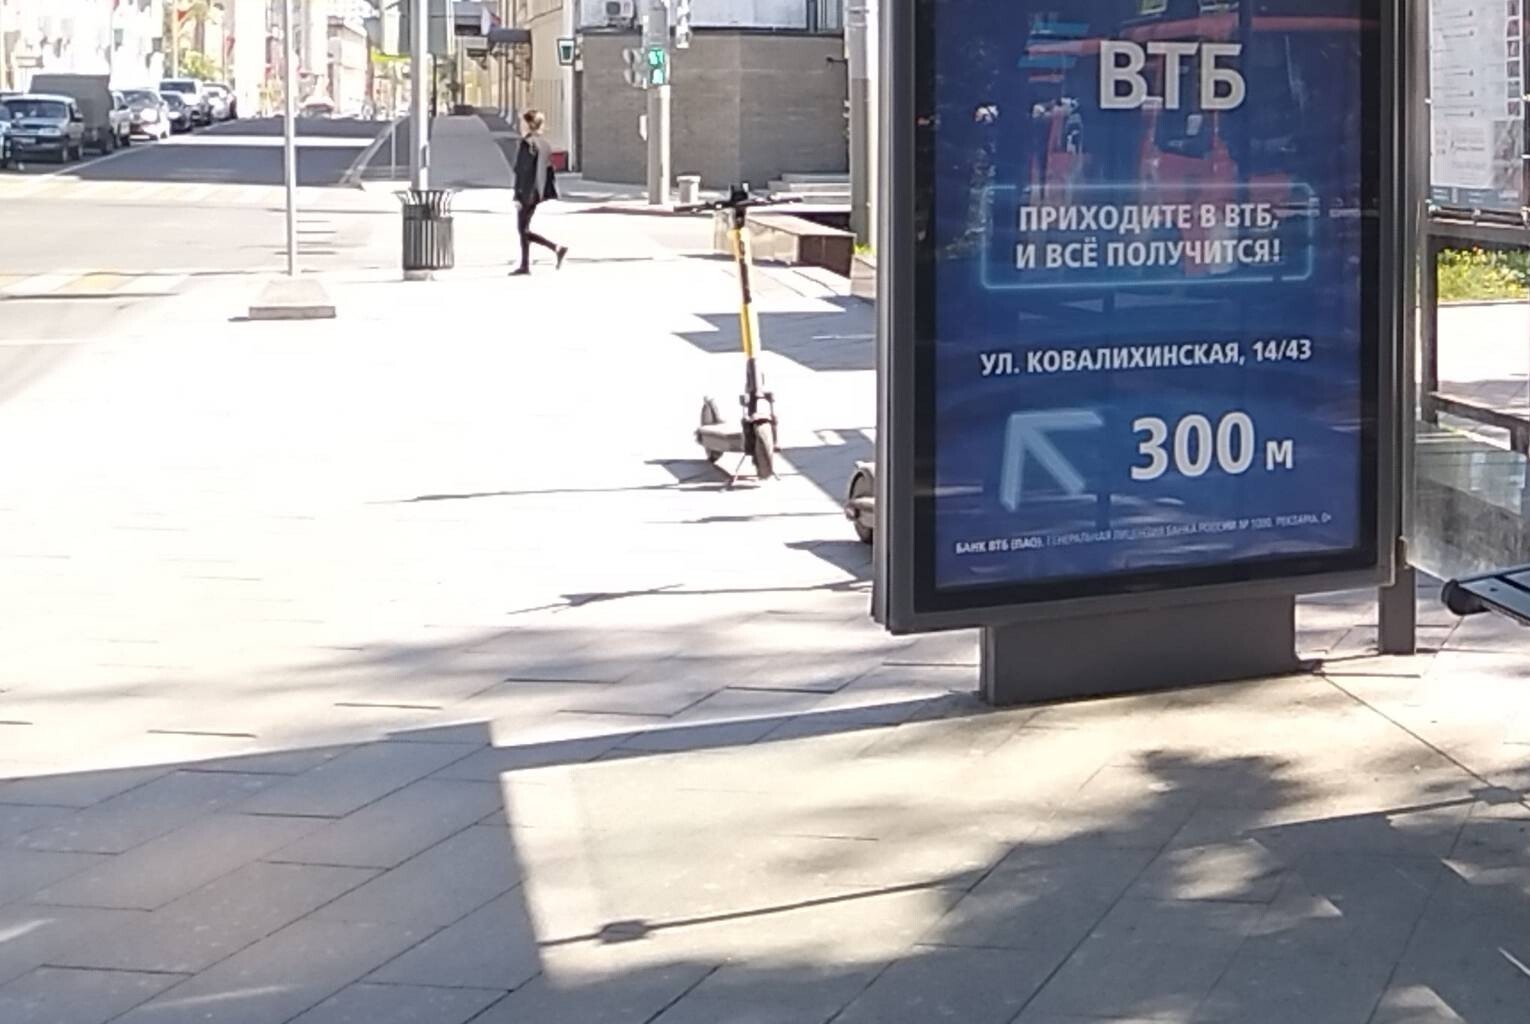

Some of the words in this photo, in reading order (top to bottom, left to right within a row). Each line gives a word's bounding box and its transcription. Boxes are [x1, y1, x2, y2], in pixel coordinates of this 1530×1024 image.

[1100, 40, 1246, 110] ВТБ
[1019, 204, 1191, 234] ПРИХОДИТЕ
[1200, 204, 1216, 228] В
[1225, 203, 1280, 230] ВТБ,
[1016, 244, 1035, 268] И
[1046, 237, 1098, 268] ВСЁ
[1107, 239, 1280, 266] ПОЛУЧИТСЯ!
[980, 352, 1019, 376] УЛ.
[1027, 342, 1245, 374] КОВАЛИХИНСКАЯ,
[1253, 339, 1312, 362] 14/43
[1130, 412, 1255, 480] 300
